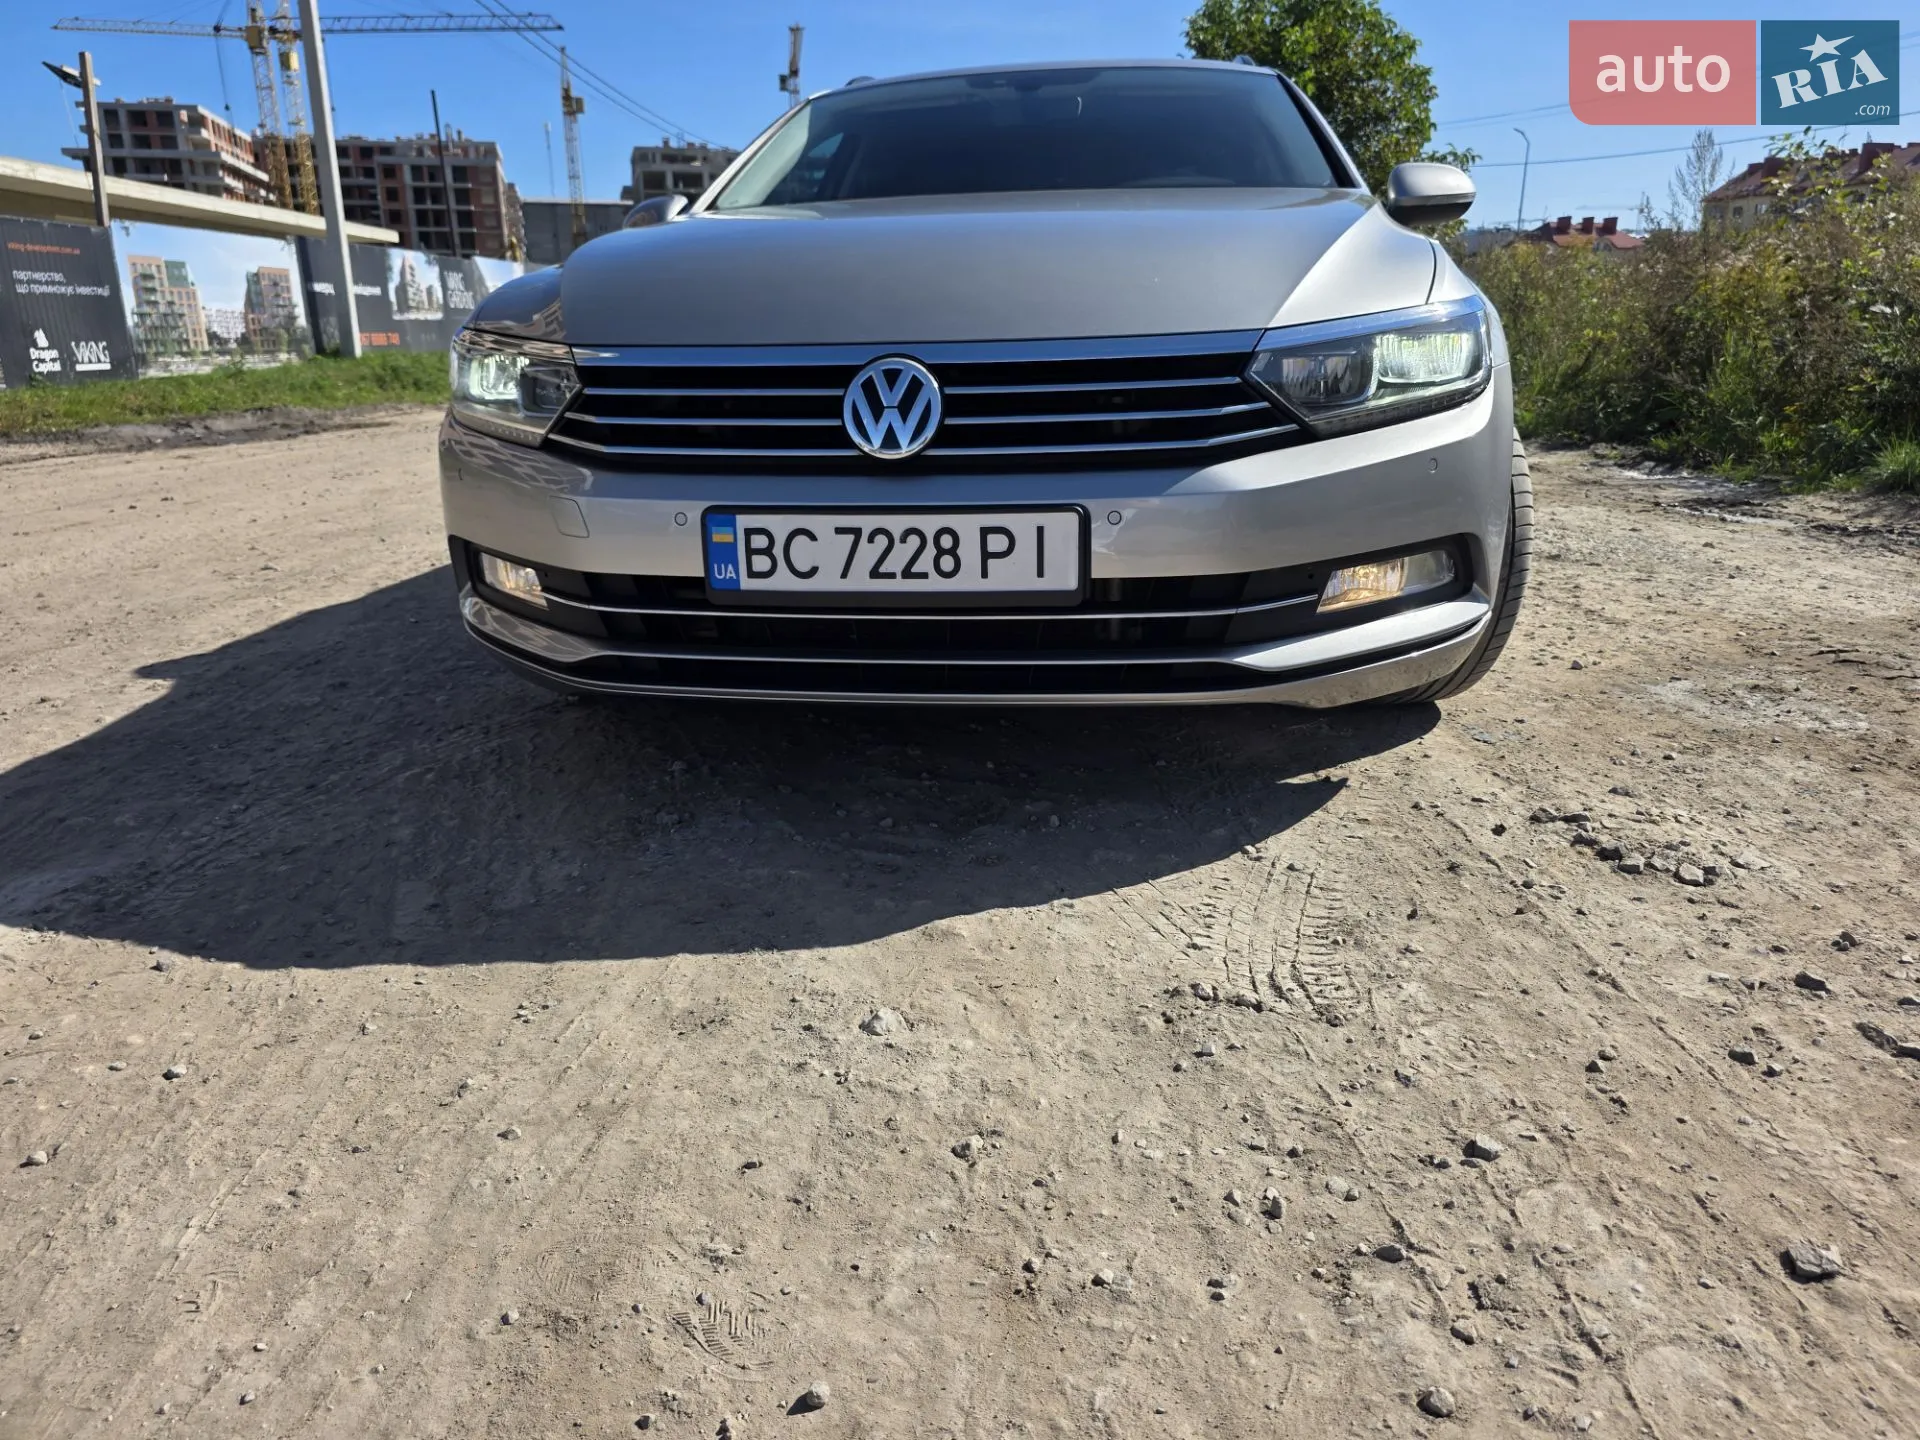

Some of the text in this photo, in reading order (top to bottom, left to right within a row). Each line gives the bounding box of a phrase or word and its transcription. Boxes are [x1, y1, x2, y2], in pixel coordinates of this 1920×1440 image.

[15, 283, 29, 294] що
[29, 347, 60, 361] Dragon
[32, 360, 62, 375] Capital
[845, 358, 939, 457] VW
[743, 527, 820, 580] BC
[834, 527, 962, 580] 7228
[714, 563, 737, 580] UA
